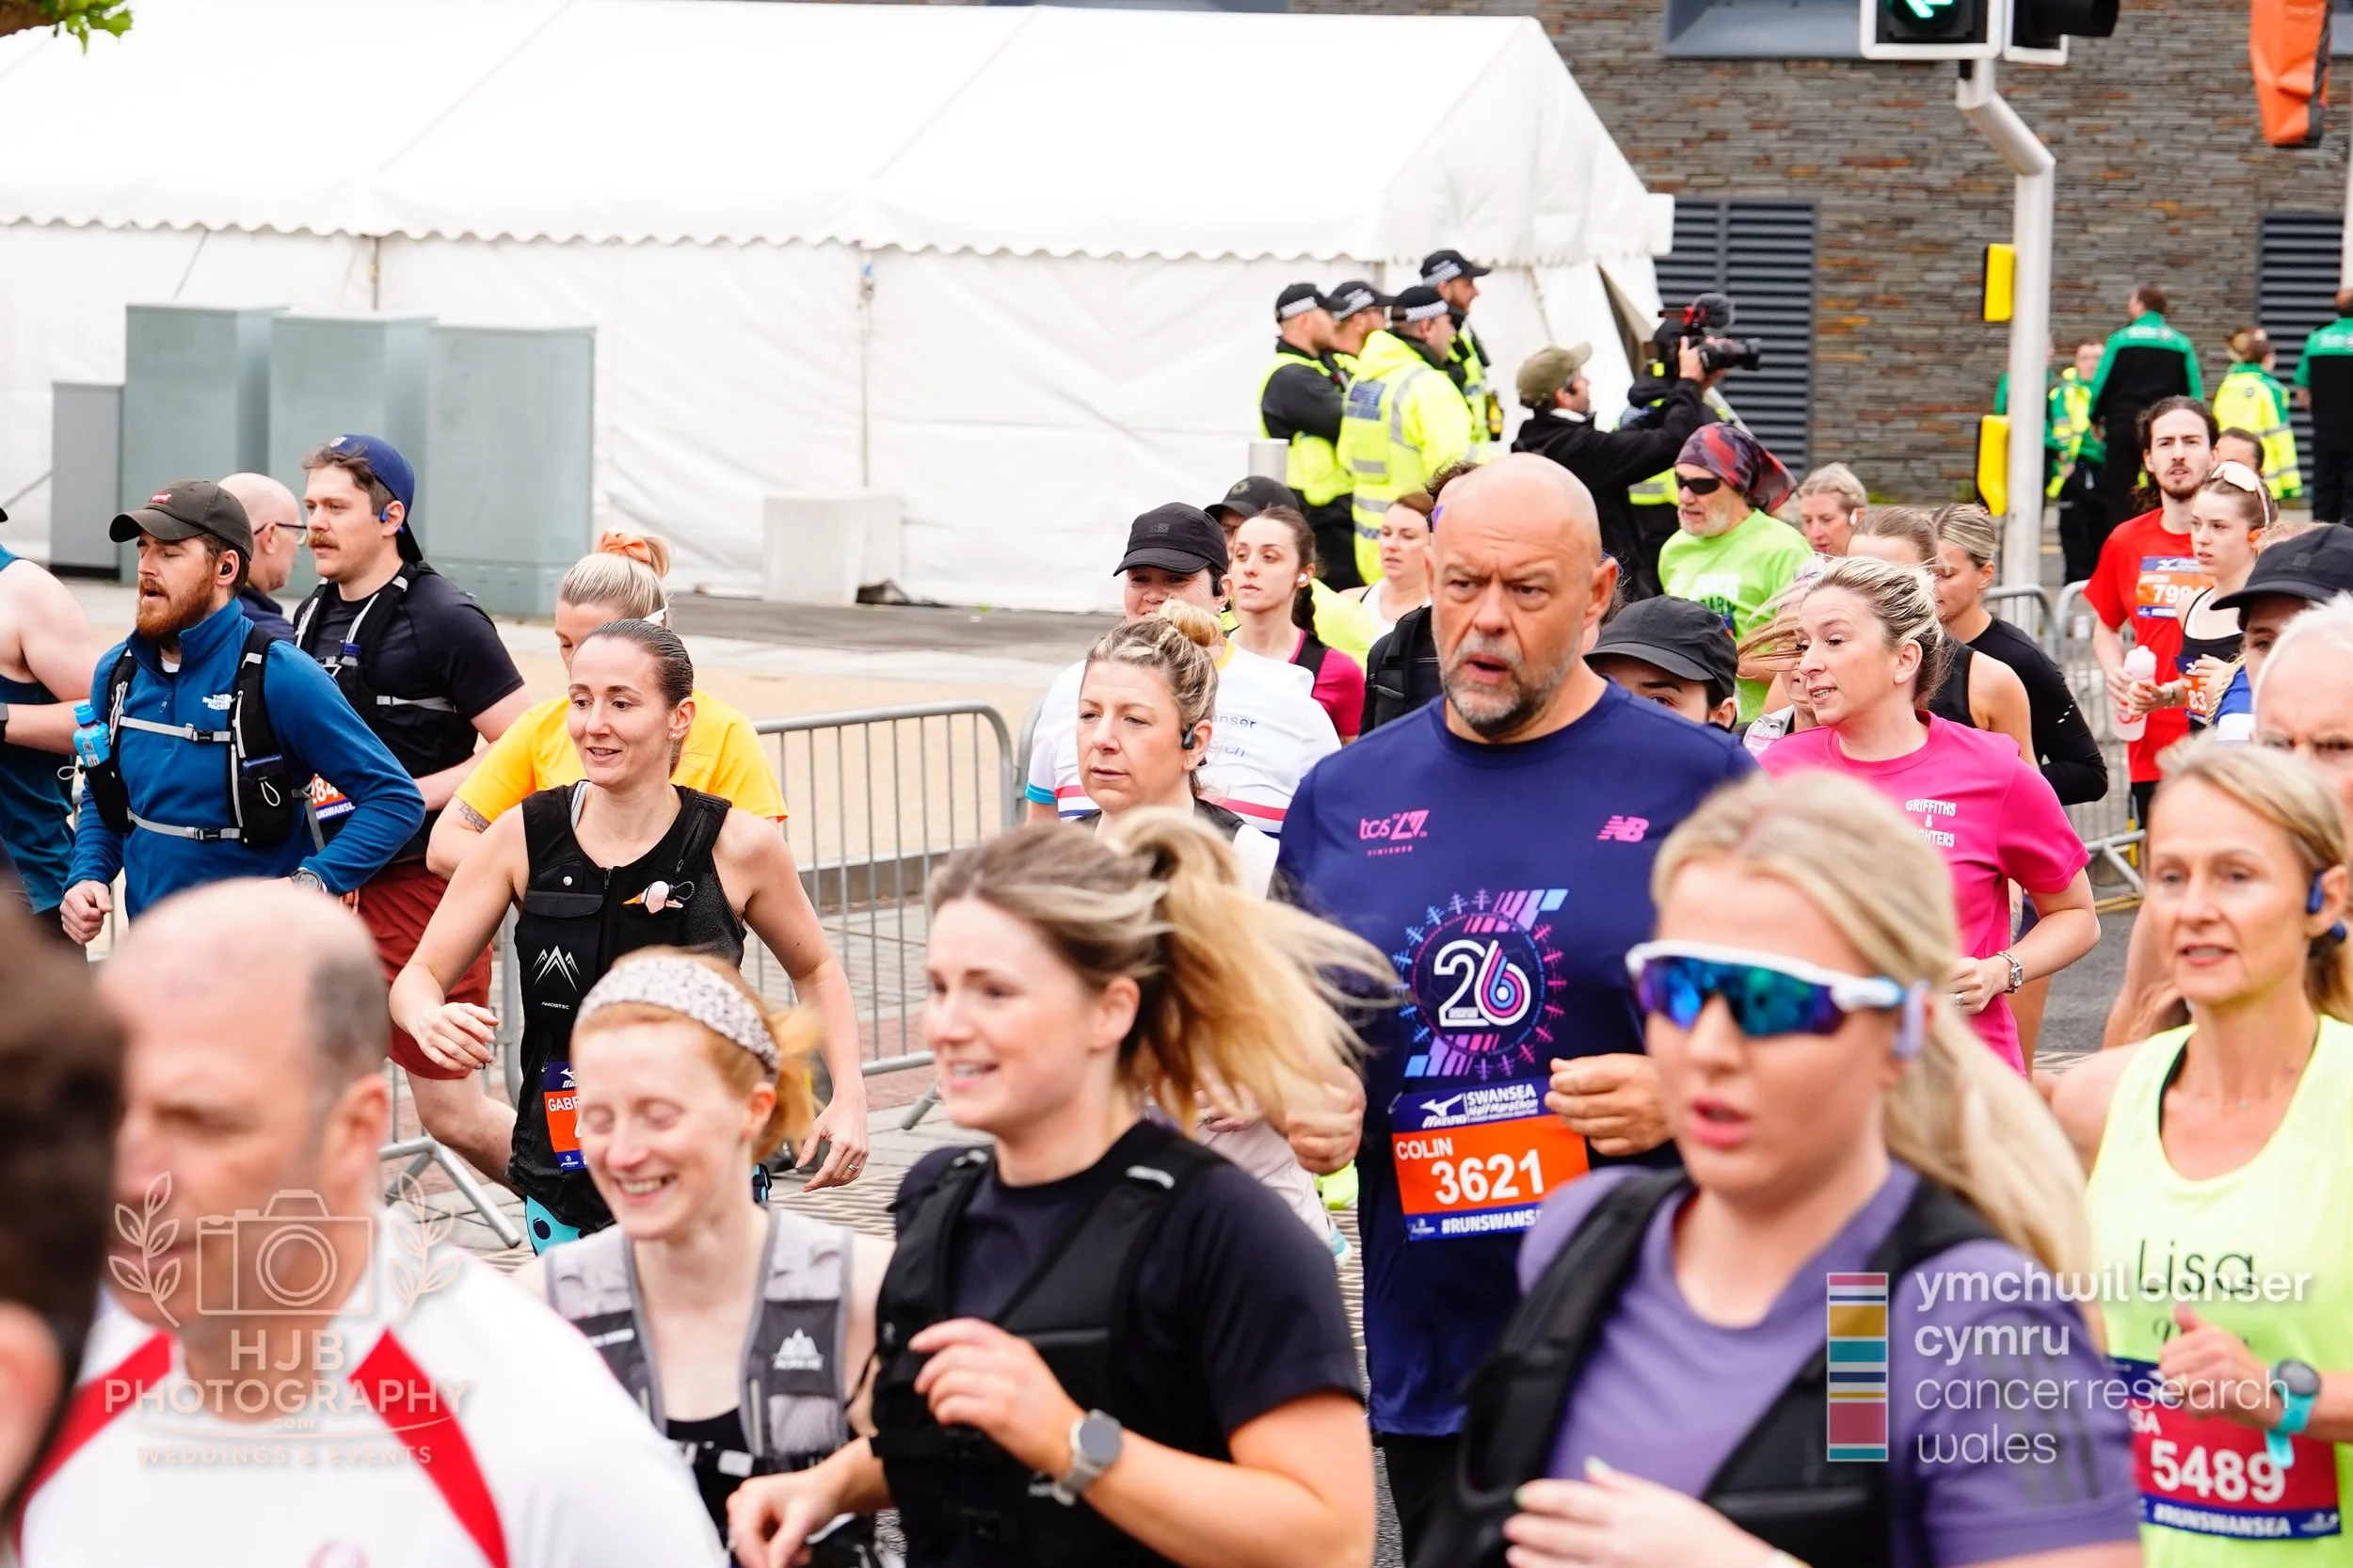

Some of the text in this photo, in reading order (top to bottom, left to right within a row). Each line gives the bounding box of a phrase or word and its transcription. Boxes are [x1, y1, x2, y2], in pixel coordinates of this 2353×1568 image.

[2153, 584, 2207, 604] 79
[1906, 798, 1957, 816] GRIFFITHS
[1359, 818, 1391, 840] tcs
[1925, 814, 1933, 828] &
[1915, 828, 1955, 848] GHTERS
[1433, 939, 1531, 1027] 26
[1466, 1083, 1536, 1107] SWANSEA
[1395, 1136, 1453, 1160] COLIN
[1431, 1147, 1545, 1206] 3621
[2138, 1239, 2253, 1295] Lisa
[2150, 1438, 2286, 1504] 5489
[2153, 1503, 2293, 1537] #RUNSWANSEA
